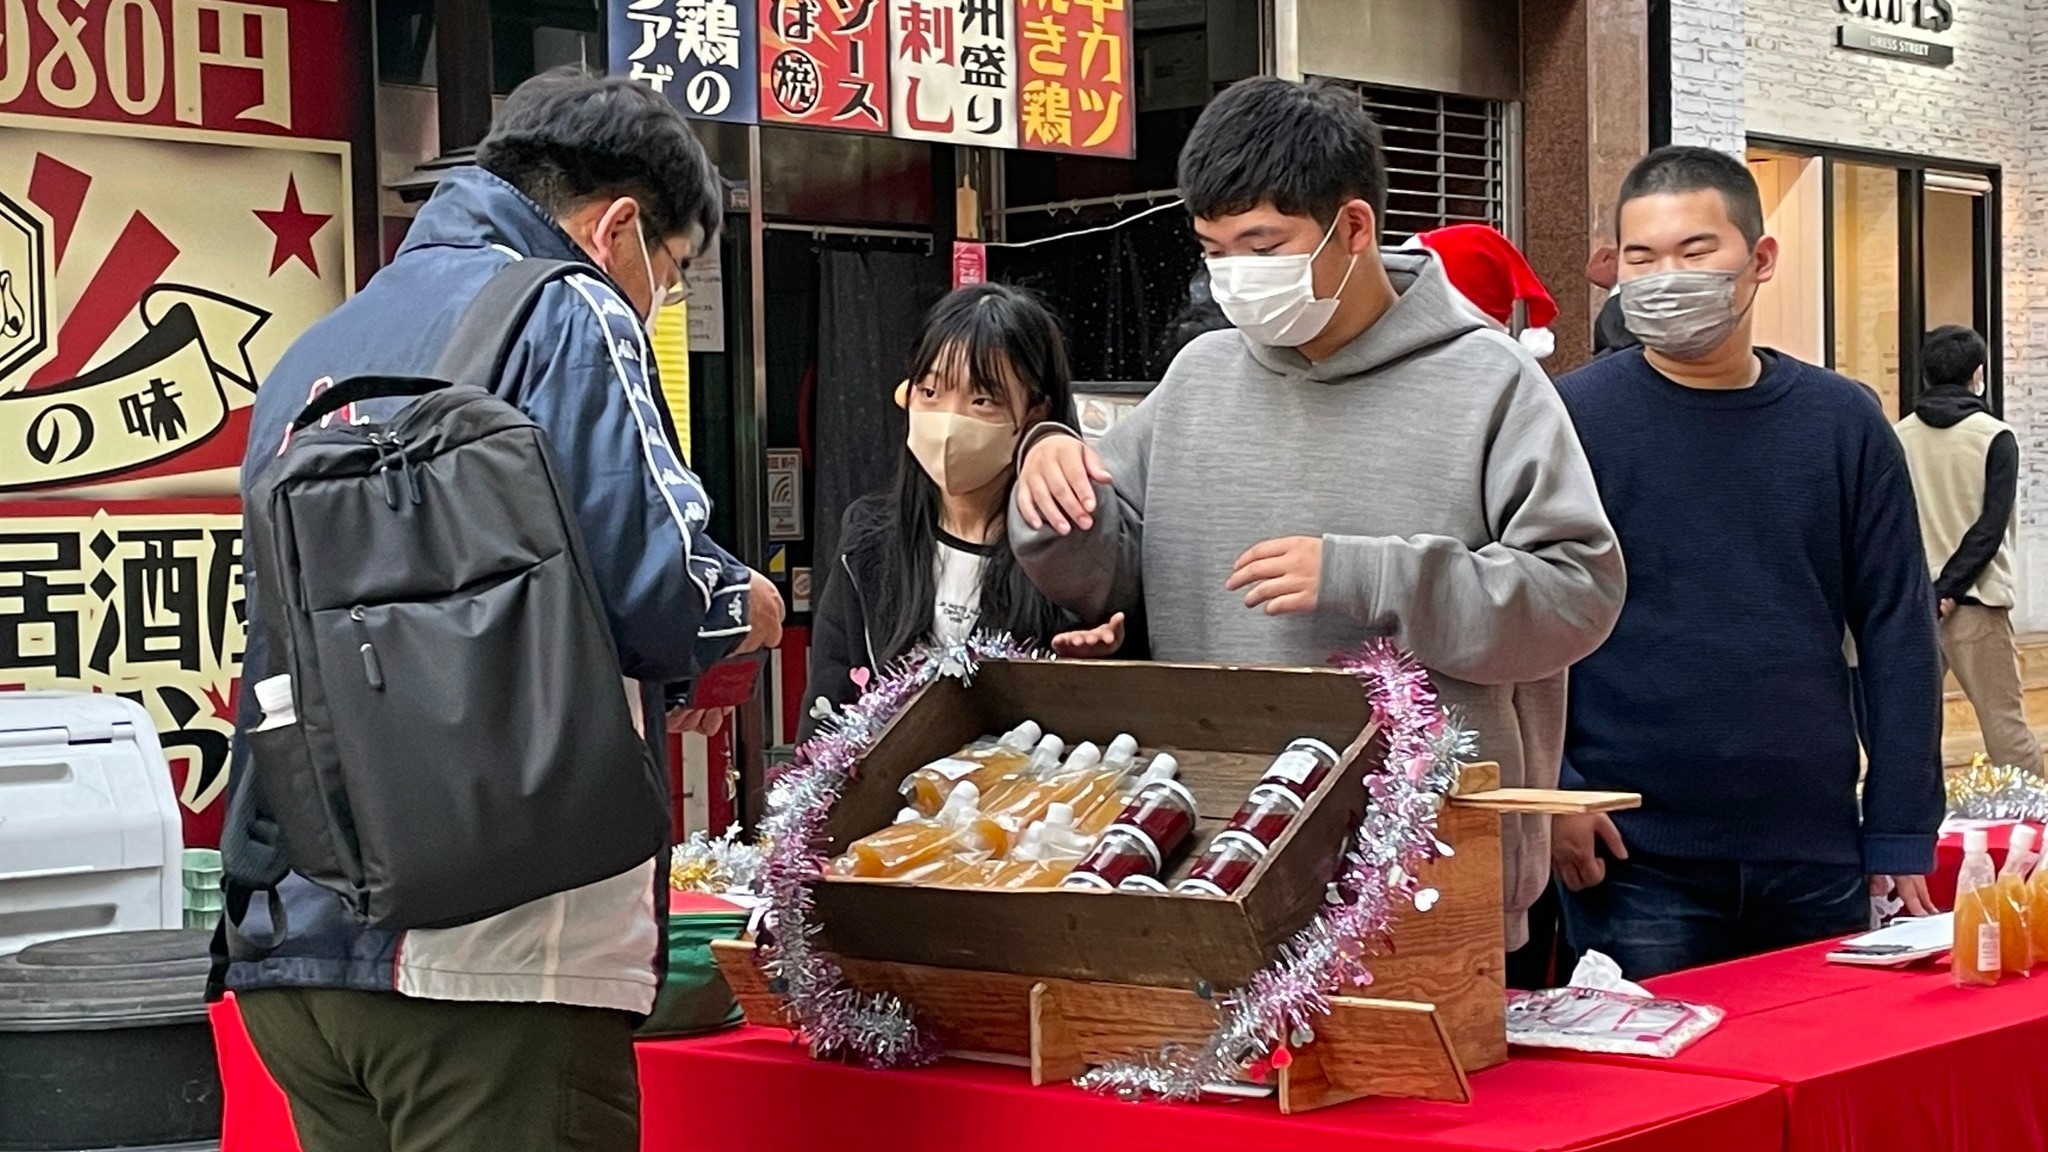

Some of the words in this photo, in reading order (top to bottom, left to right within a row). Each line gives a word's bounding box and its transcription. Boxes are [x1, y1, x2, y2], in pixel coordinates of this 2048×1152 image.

[898, 1, 955, 133] 刺し
[1870, 35, 1898, 50] DRESS
[1899, 40, 1929, 56] STREET
